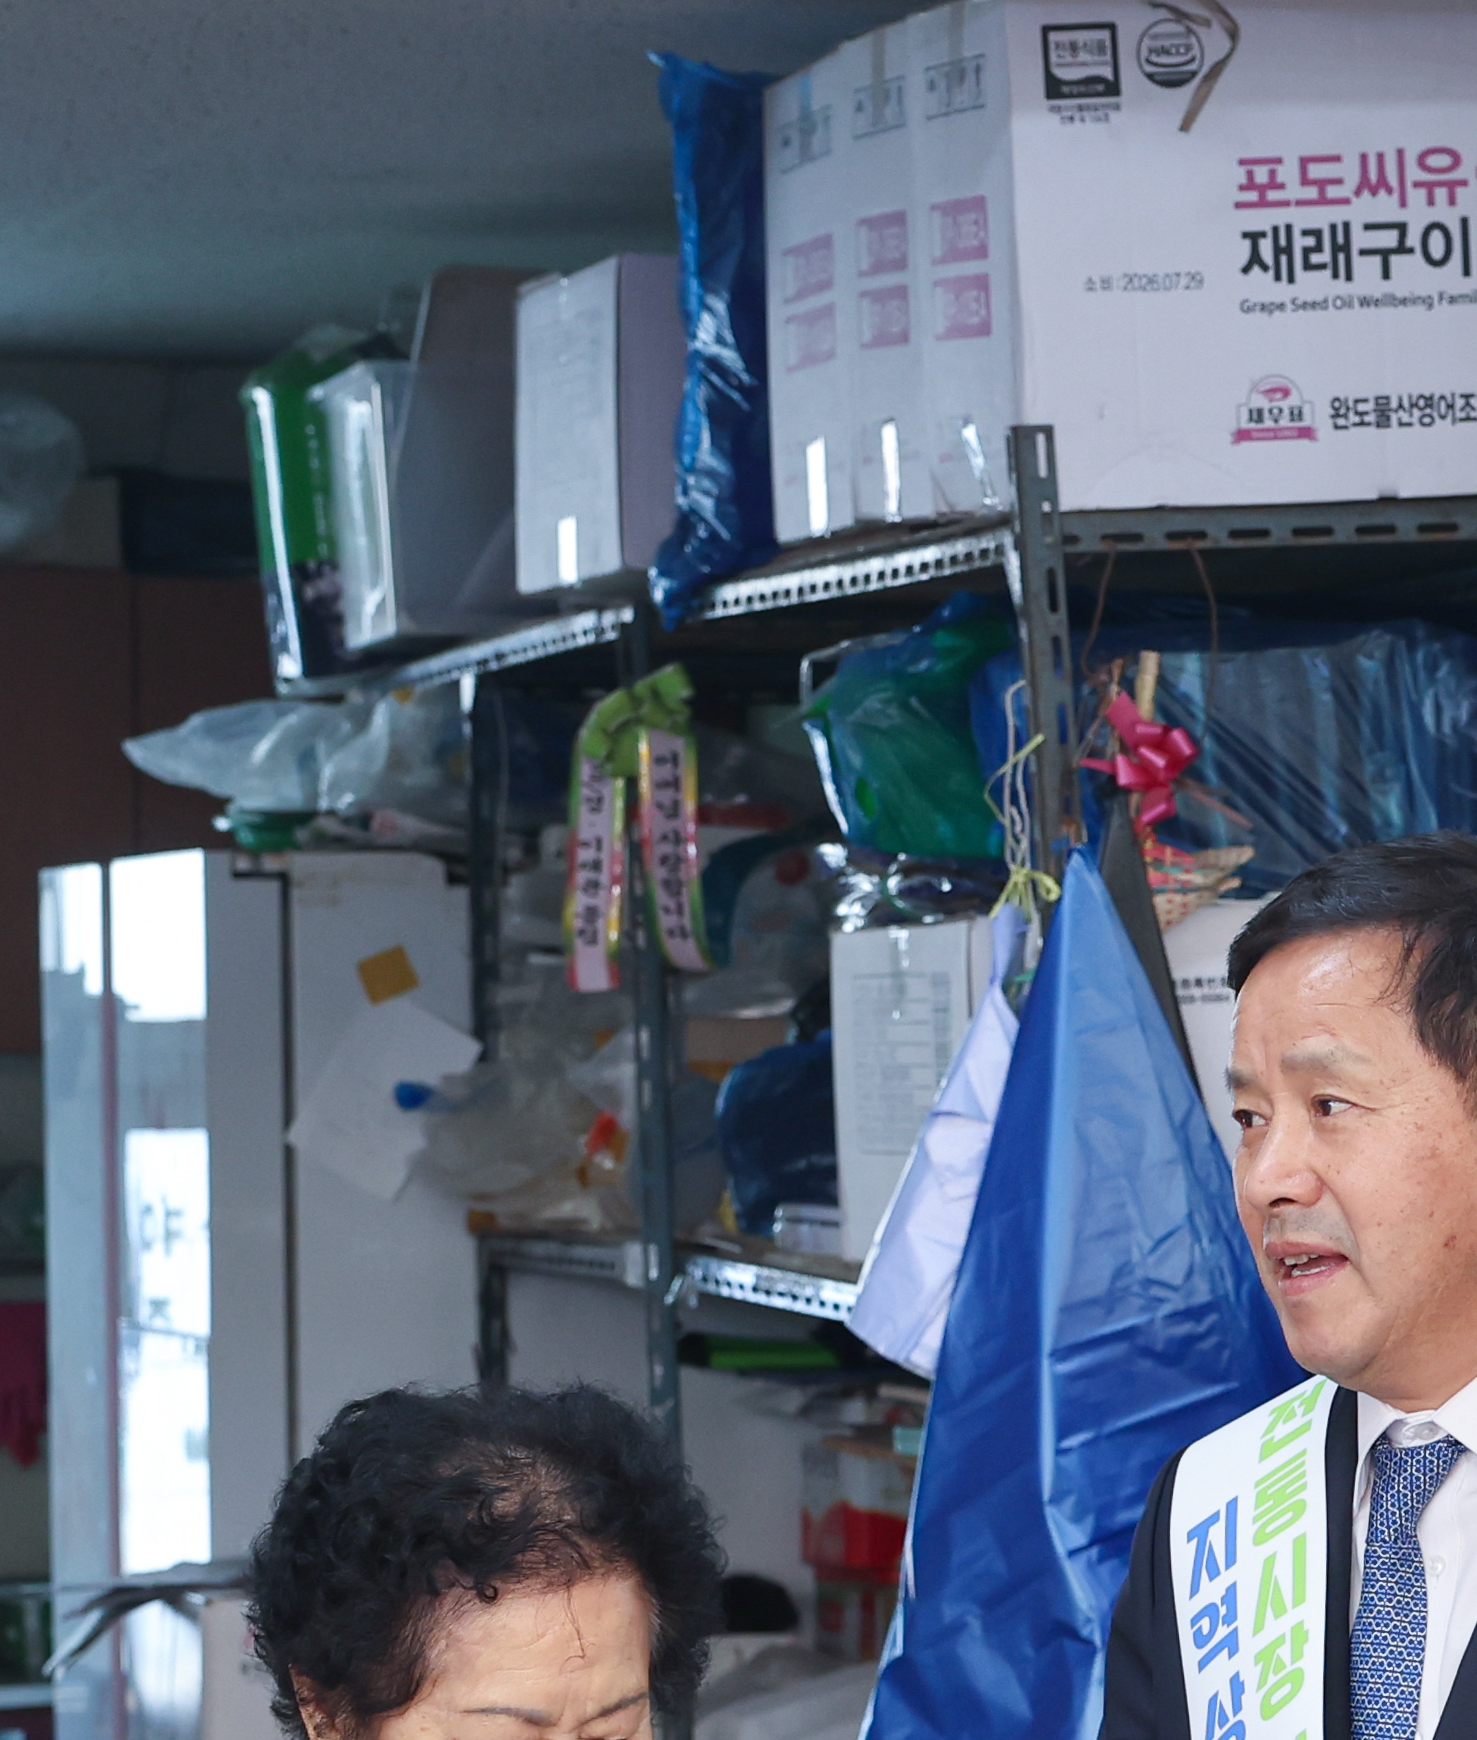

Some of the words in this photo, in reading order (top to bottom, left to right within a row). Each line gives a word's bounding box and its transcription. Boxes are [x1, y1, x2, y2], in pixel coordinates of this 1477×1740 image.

[1233, 146, 1469, 209] 포도씨유
[1240, 297, 1287, 315] Grape
[1290, 297, 1329, 313] Seed
[1332, 295, 1355, 311] Oil
[1357, 293, 1434, 311] Wellbeing
[1246, 405, 1305, 426] 새우표
[1252, 1380, 1326, 1724] 전통시장
